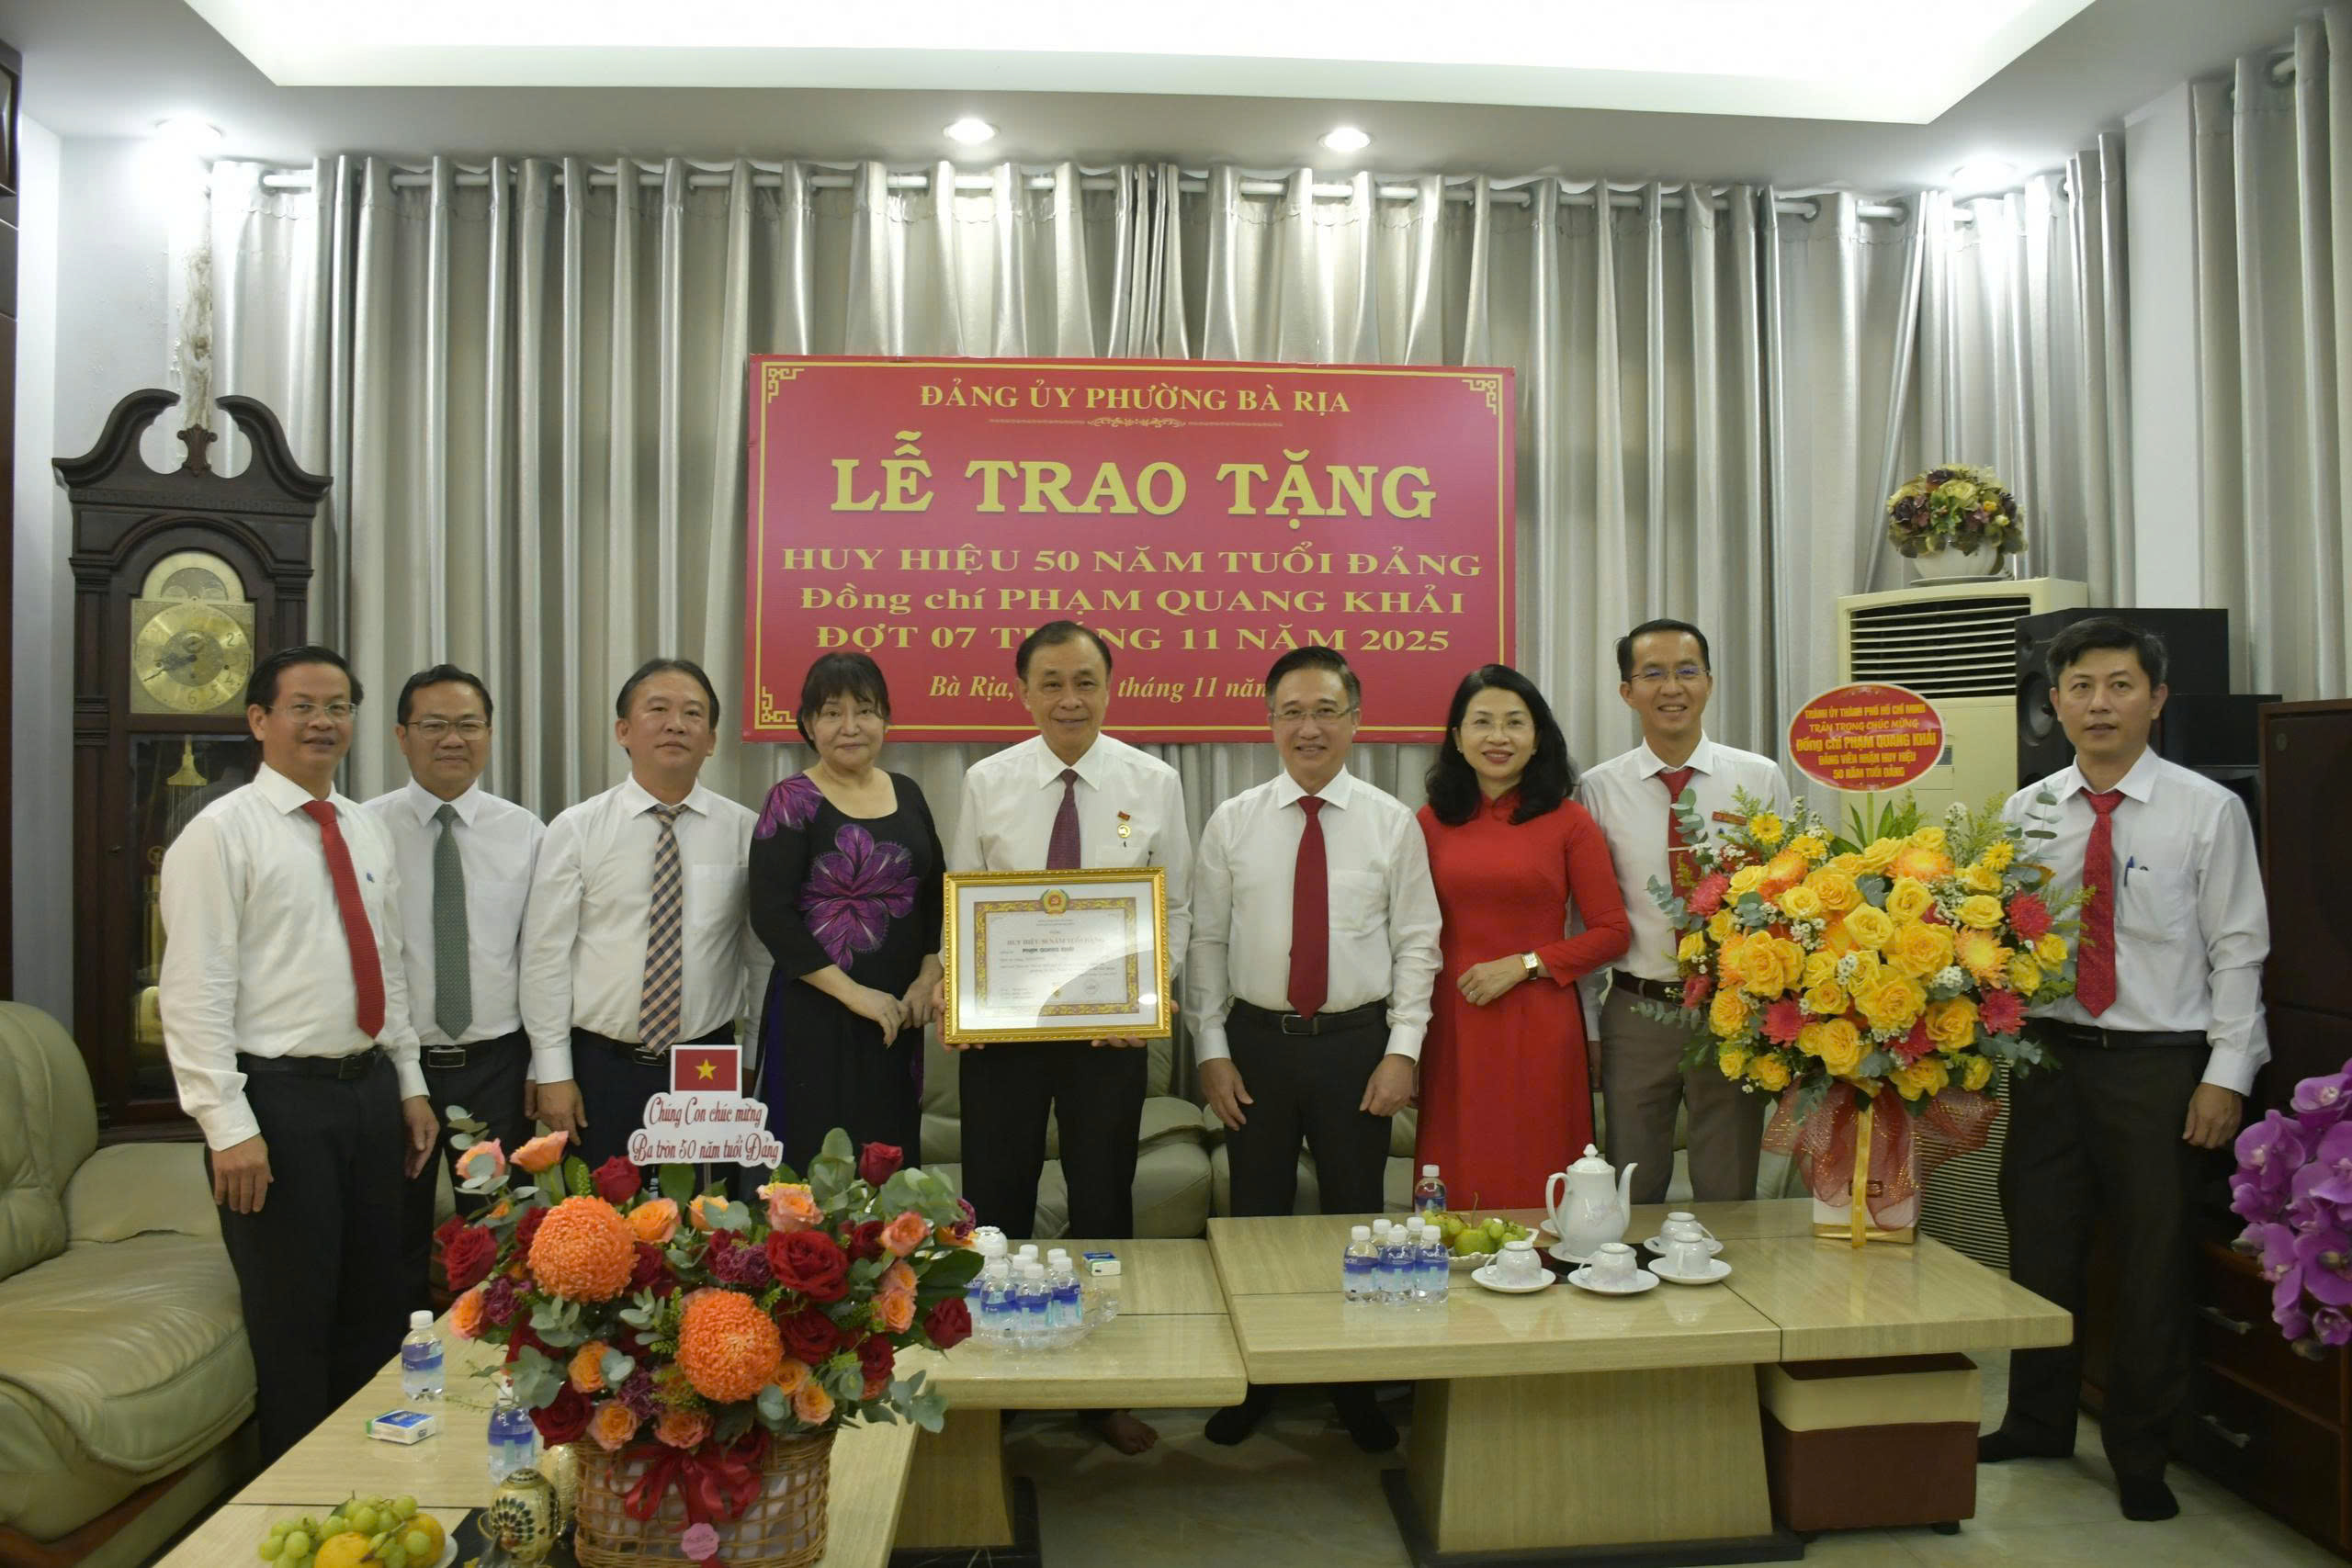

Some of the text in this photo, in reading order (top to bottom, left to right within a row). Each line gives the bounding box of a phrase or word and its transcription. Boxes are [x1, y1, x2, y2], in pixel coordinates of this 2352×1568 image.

[920, 378, 1351, 416] ĐẢNG ỦY PHƯỜNG BÀ RỊA
[830, 430, 1437, 530] LỄ TRAO TẶNG
[780, 541, 1483, 577] HUY HIỆU 50 NĂM TUỔI ĐẢNG
[800, 582, 1465, 615] Đồng chí PHẠM QUANG KHẢI
[817, 622, 1450, 653] ĐỢT 07 TNG 11 NĂM 2025
[929, 675, 961, 697] Bà
[969, 675, 1014, 703] Rịa,
[1117, 677, 1185, 703] tháng
[1193, 676, 1219, 697] 11
[649, 1096, 763, 1128] Chúng Con chúc mừng
[632, 1133, 781, 1164] Ba tròn 50 năm tuổi Đảng
